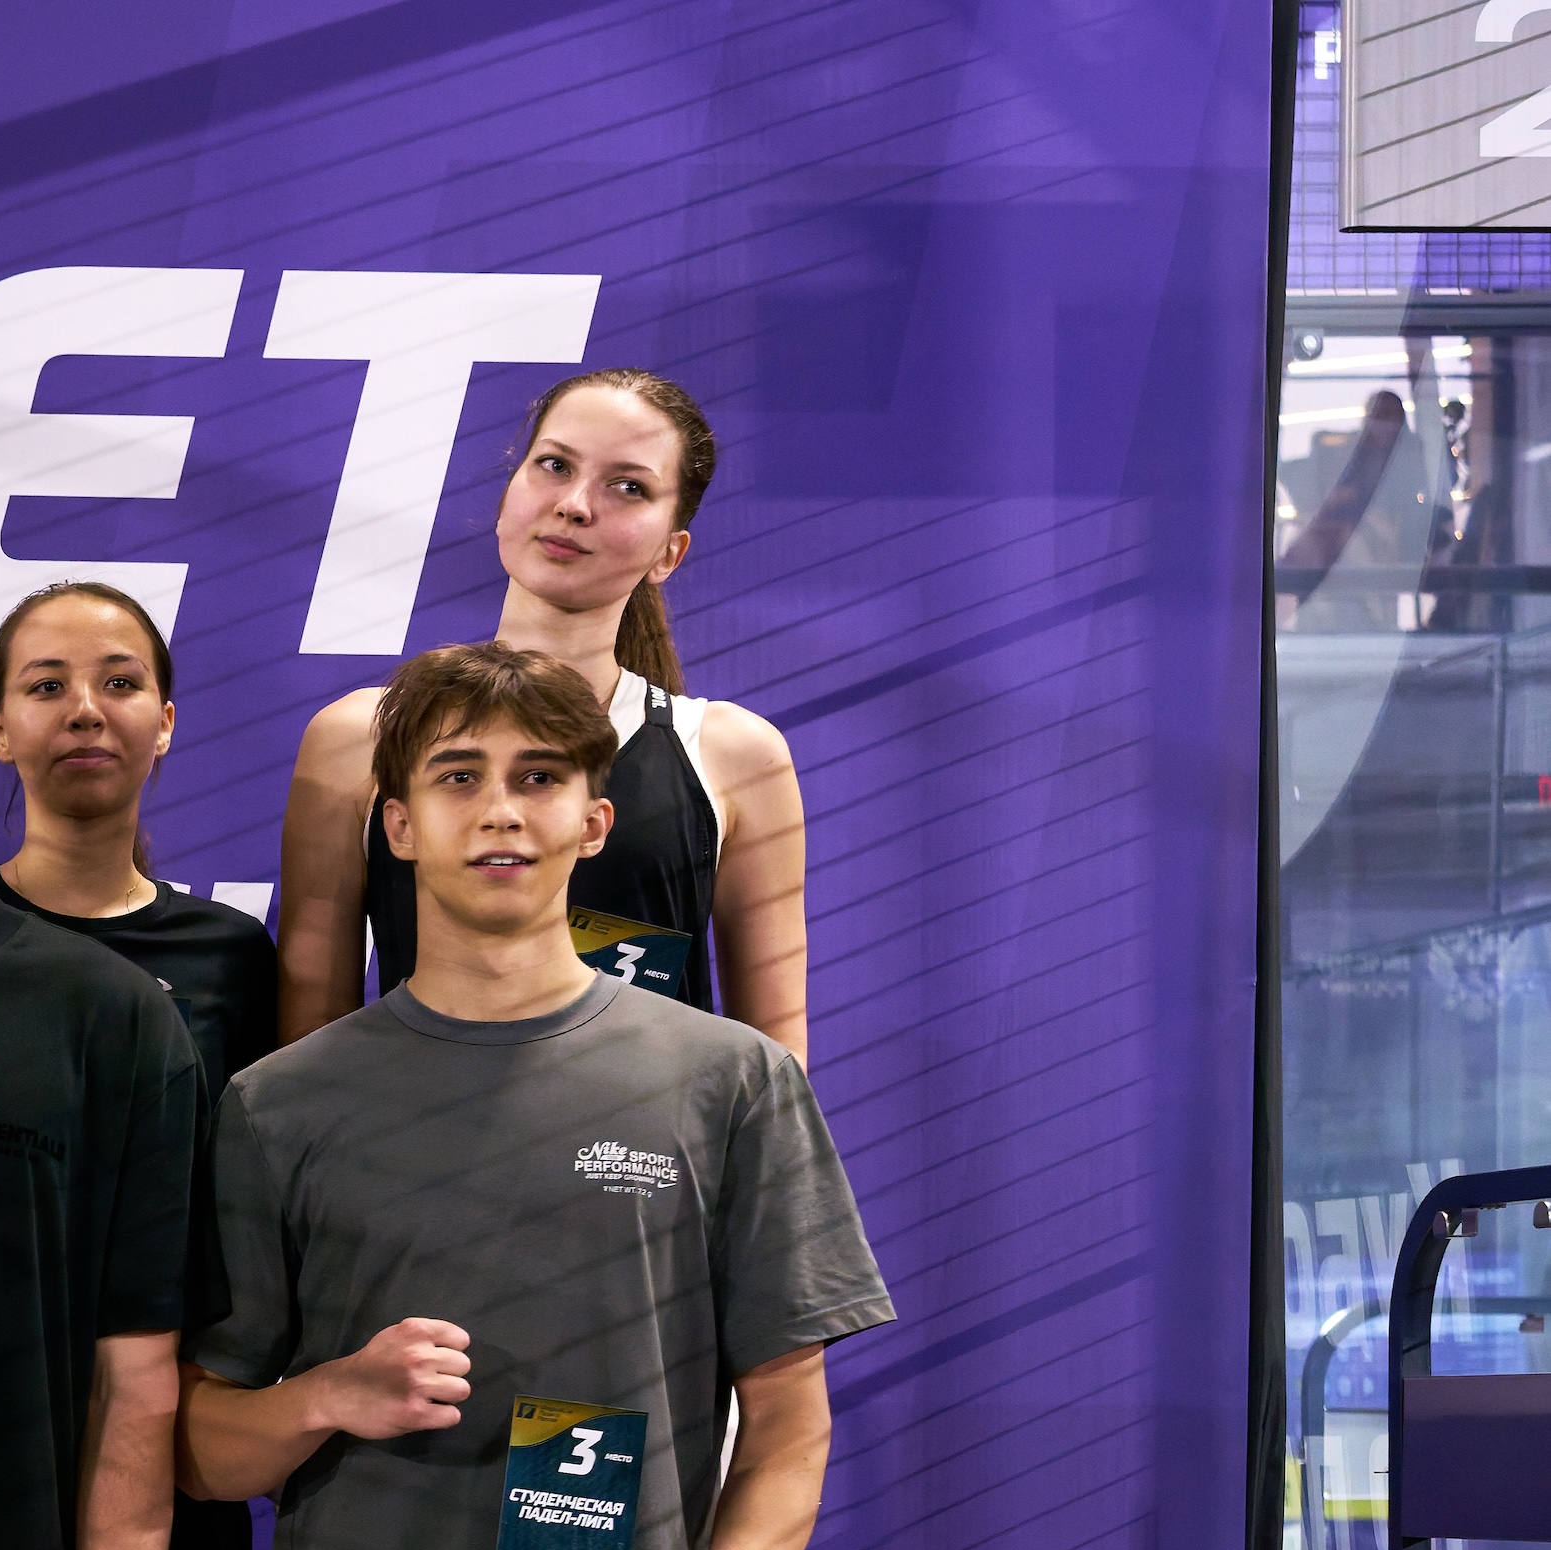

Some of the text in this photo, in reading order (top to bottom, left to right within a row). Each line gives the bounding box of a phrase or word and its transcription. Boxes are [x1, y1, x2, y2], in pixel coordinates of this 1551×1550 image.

[613, 942, 670, 986] 3 место
[577, 1141, 675, 1168] Nike SPORT
[574, 1160, 679, 1182] PERFORMANCE
[585, 1172, 603, 1180] JUST
[557, 1427, 633, 1476] 3 место
[508, 1487, 625, 1517] СТУДЕНЧЕСКАЯ
[518, 1504, 614, 1531] ПАДЕЛ-ЛИГА
